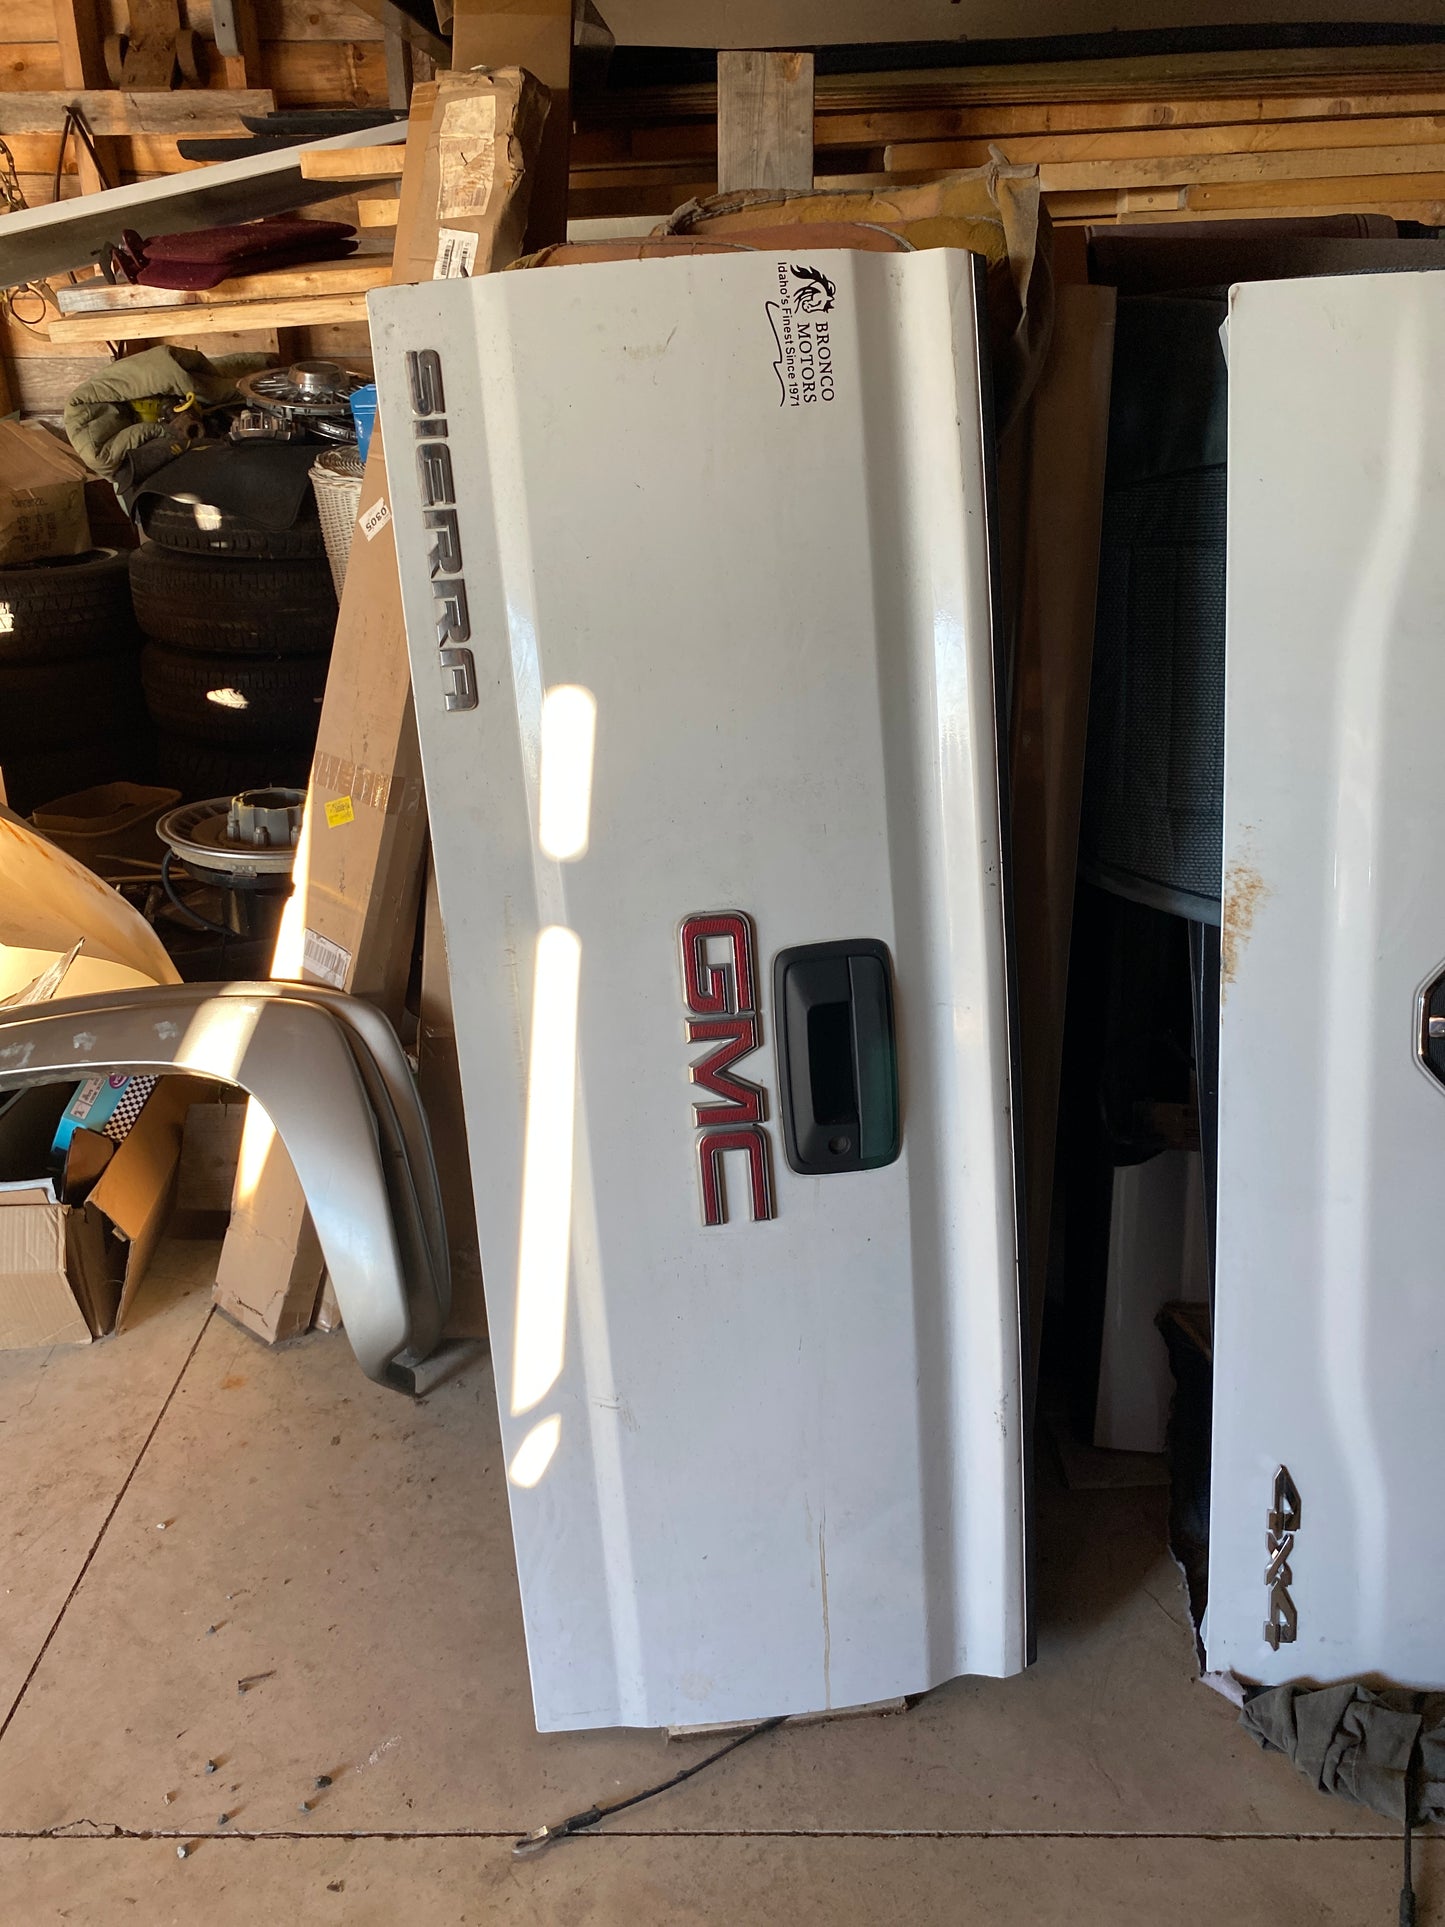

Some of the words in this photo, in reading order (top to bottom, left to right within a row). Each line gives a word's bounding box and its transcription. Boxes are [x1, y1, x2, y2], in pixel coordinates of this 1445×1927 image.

[777, 262, 790, 305] Idaho's
[782, 308, 794, 345] Finest
[786, 347, 797, 379] Since
[797, 323, 817, 403] MOTORS
[815, 321, 835, 402] BRONCO
[789, 382, 800, 407] 1971
[366, 507, 387, 532] 0305
[405, 350, 479, 711] SIERRA
[680, 911, 776, 1225] GMC
